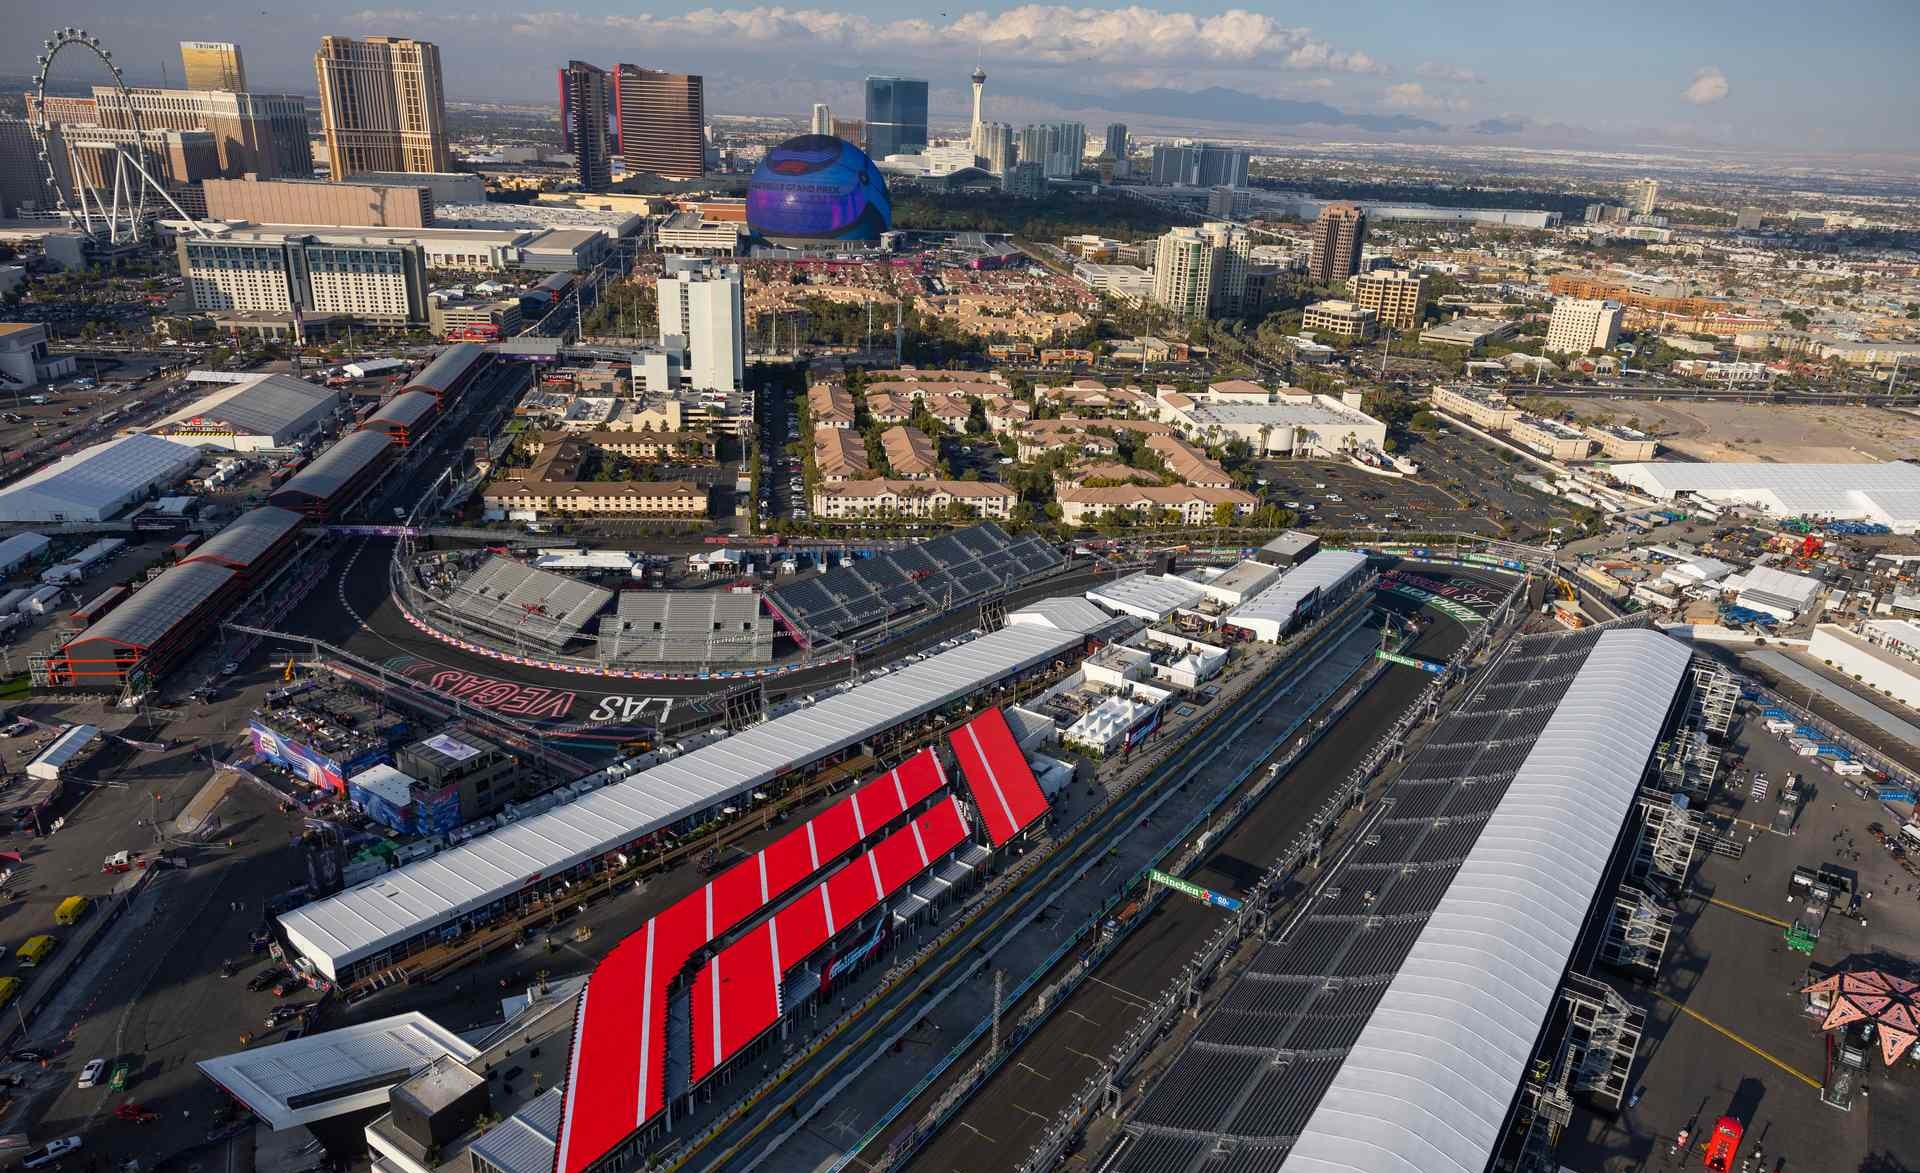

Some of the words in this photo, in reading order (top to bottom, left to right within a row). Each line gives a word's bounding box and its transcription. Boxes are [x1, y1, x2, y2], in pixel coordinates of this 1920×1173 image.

[1380, 650, 1415, 667] Heineken
[431, 670, 577, 718] VEGAS
[590, 695, 674, 723] LAS
[1153, 871, 1199, 897] Heineken
